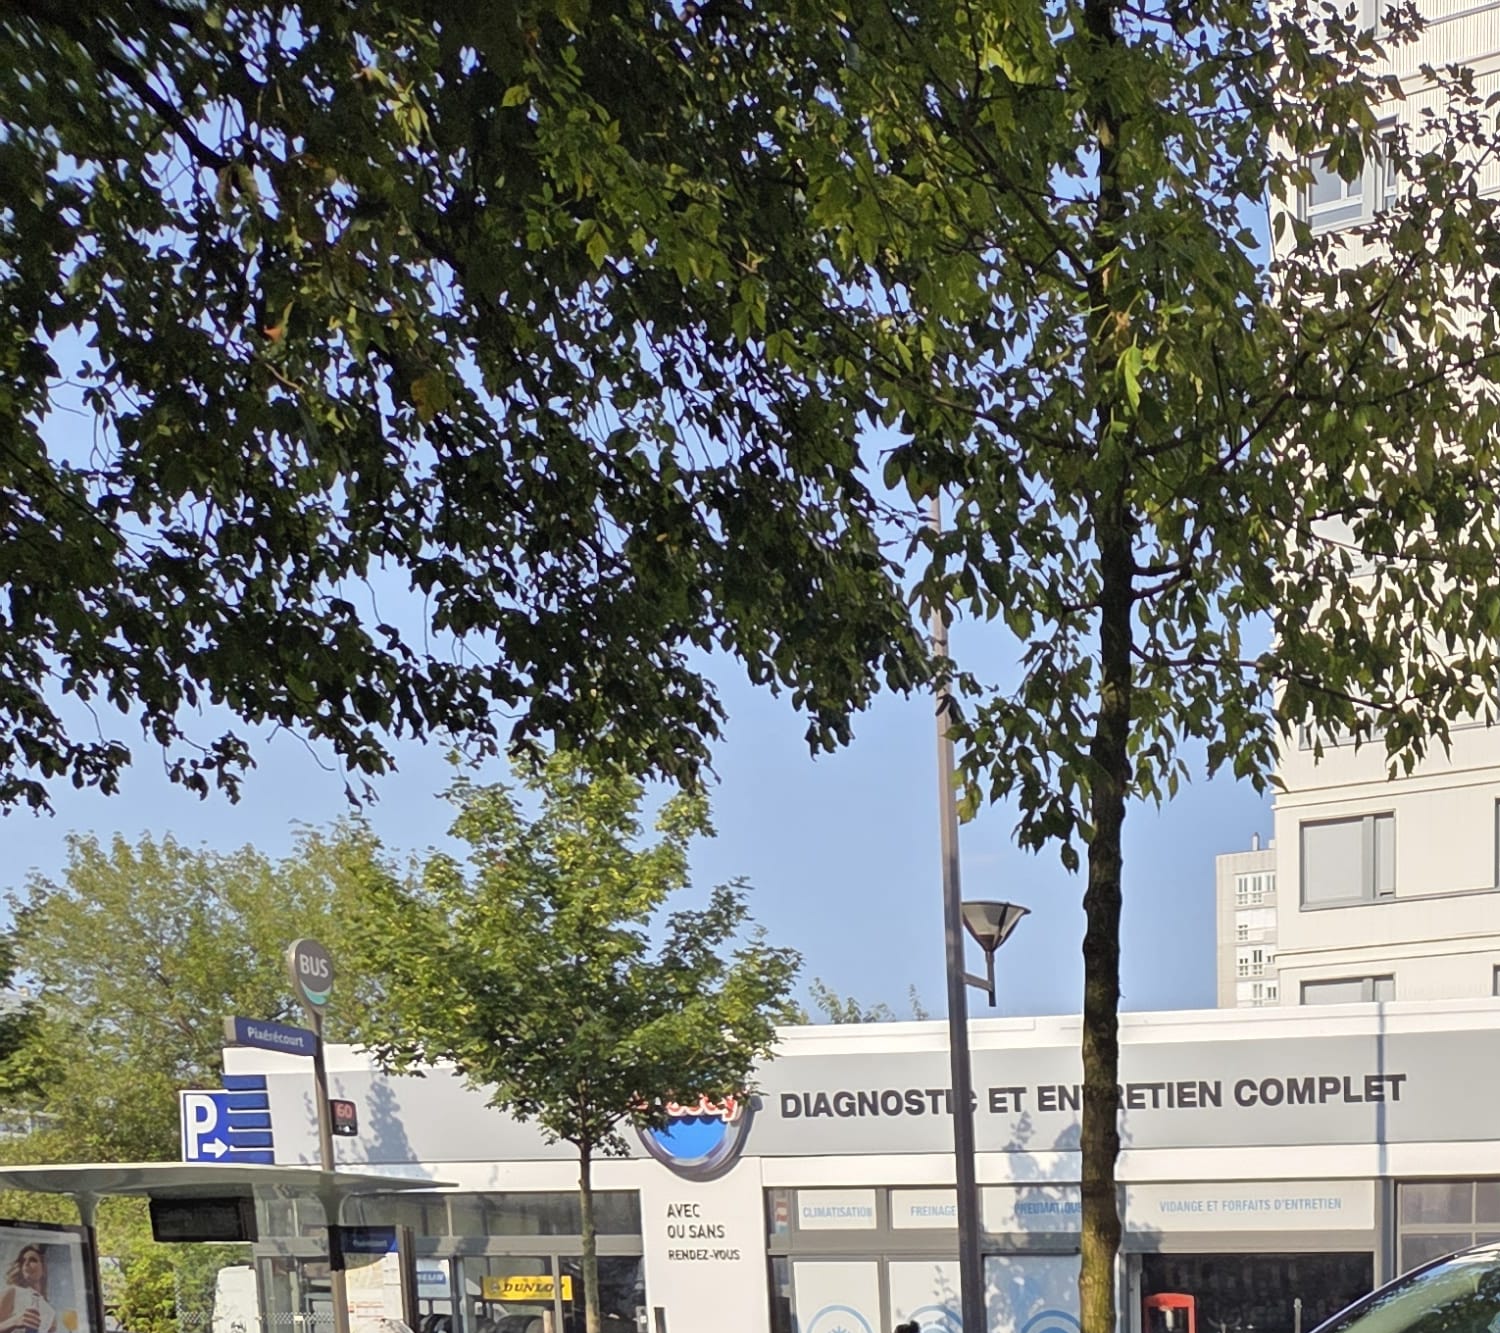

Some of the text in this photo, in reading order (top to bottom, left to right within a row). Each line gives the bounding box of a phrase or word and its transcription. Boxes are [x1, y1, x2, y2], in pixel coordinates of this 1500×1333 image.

[300, 954, 329, 979] BUS
[247, 1026, 305, 1048] Pixérécourt
[988, 1087, 1027, 1113] ET
[1037, 1080, 1222, 1112] ENETIEN
[1234, 1074, 1407, 1106] COMPLET
[336, 1103, 353, 1118] 60
[185, 1095, 218, 1159] P
[667, 1203, 700, 1218] AVEC
[803, 1206, 873, 1219] CLIMATISATION
[910, 1205, 956, 1217] FREINAGE
[1160, 1197, 1342, 1213] VIDANGE ET FORFAITS D'ENTRETIEN
[667, 1224, 725, 1239] OU SANS
[668, 1249, 740, 1261] RENDEZ-VOUS
